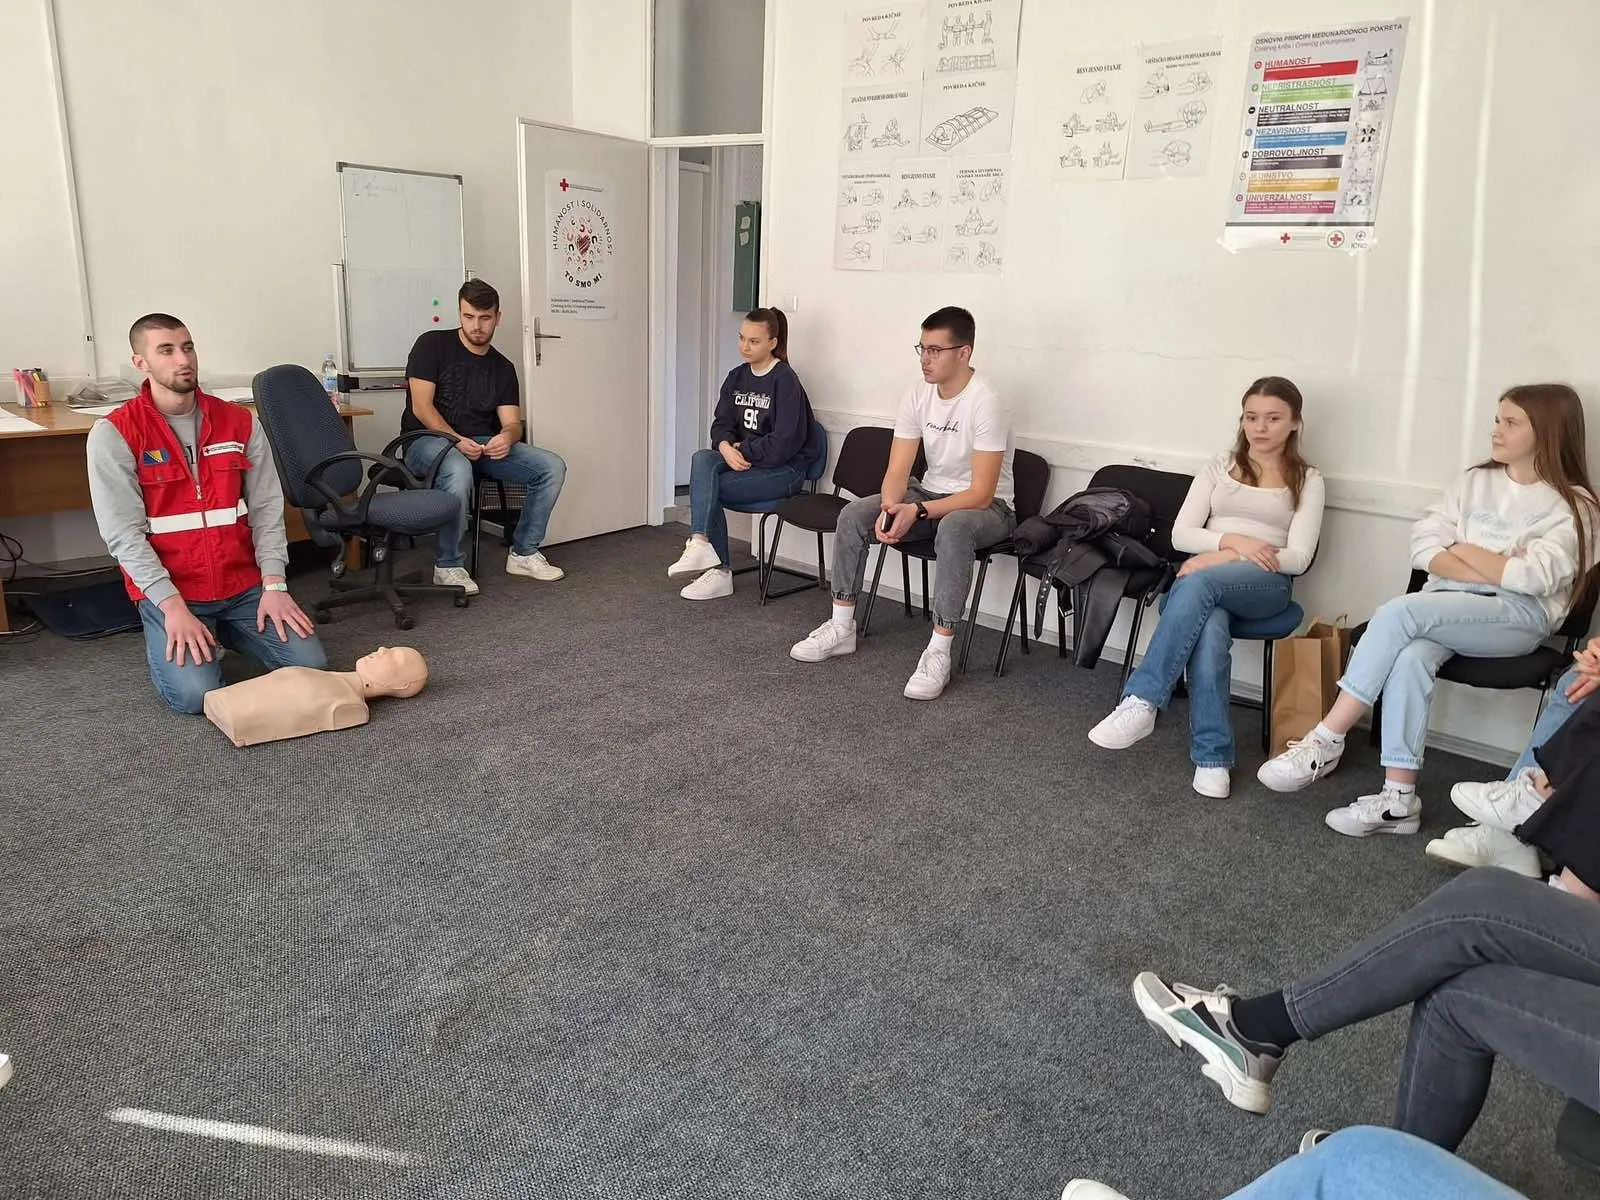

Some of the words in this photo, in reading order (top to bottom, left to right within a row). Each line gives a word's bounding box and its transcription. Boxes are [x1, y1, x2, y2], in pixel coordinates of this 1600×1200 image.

[1255, 35, 1283, 45] OSNOVNI
[1284, 33, 1311, 41] PRINCIPI
[1369, 23, 1402, 33] POKRETA
[1264, 57, 1312, 68] HUMANOST
[1258, 103, 1319, 113] NEUTRALNOST
[1256, 126, 1312, 135] NEZAVISNOST
[1252, 148, 1325, 158] DOBROVOLJNOST
[1247, 193, 1312, 201] UNIVERZALNOST
[552, 201, 574, 250] HUMANOST
[581, 200, 613, 255] SOLIDARNOST
[565, 271, 573, 282] TO
[593, 273, 602, 284] MI
[744, 409, 759, 430] 95
